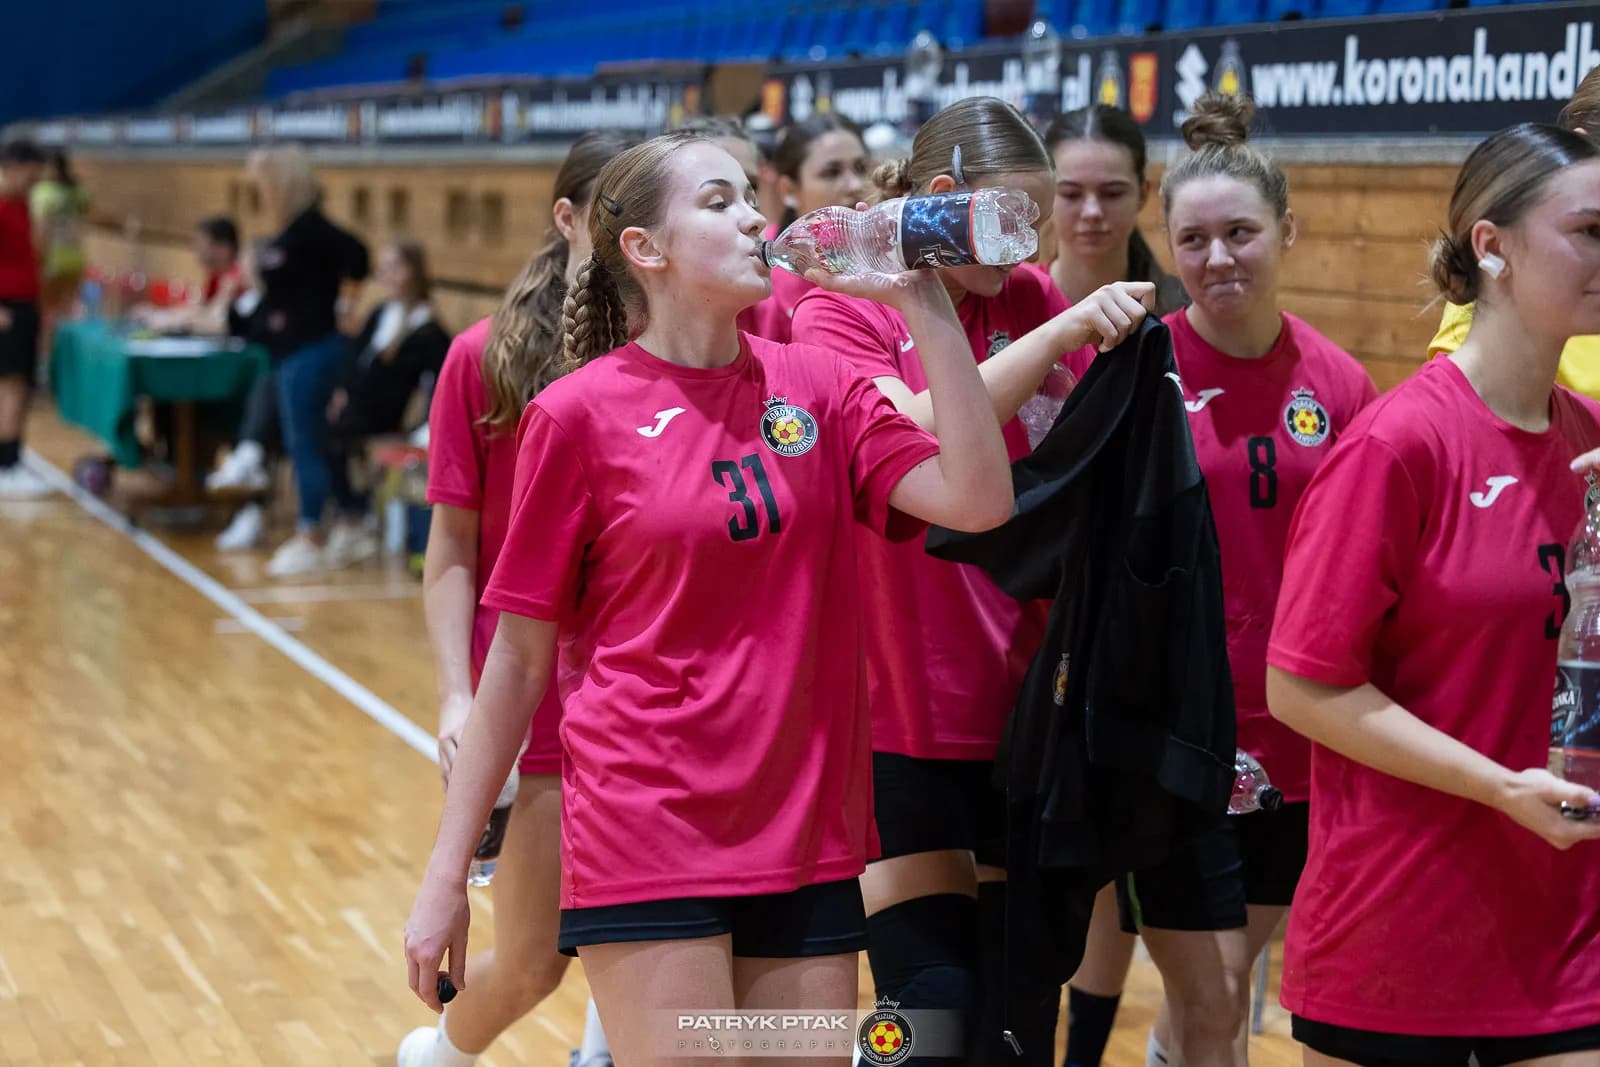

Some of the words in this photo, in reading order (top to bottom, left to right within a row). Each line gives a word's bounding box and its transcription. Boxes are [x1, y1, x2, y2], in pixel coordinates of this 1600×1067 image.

[766, 408, 797, 422] KORONA
[777, 435, 813, 453] HANDBALL
[1247, 436, 1277, 509] 8
[712, 454, 781, 542] 31
